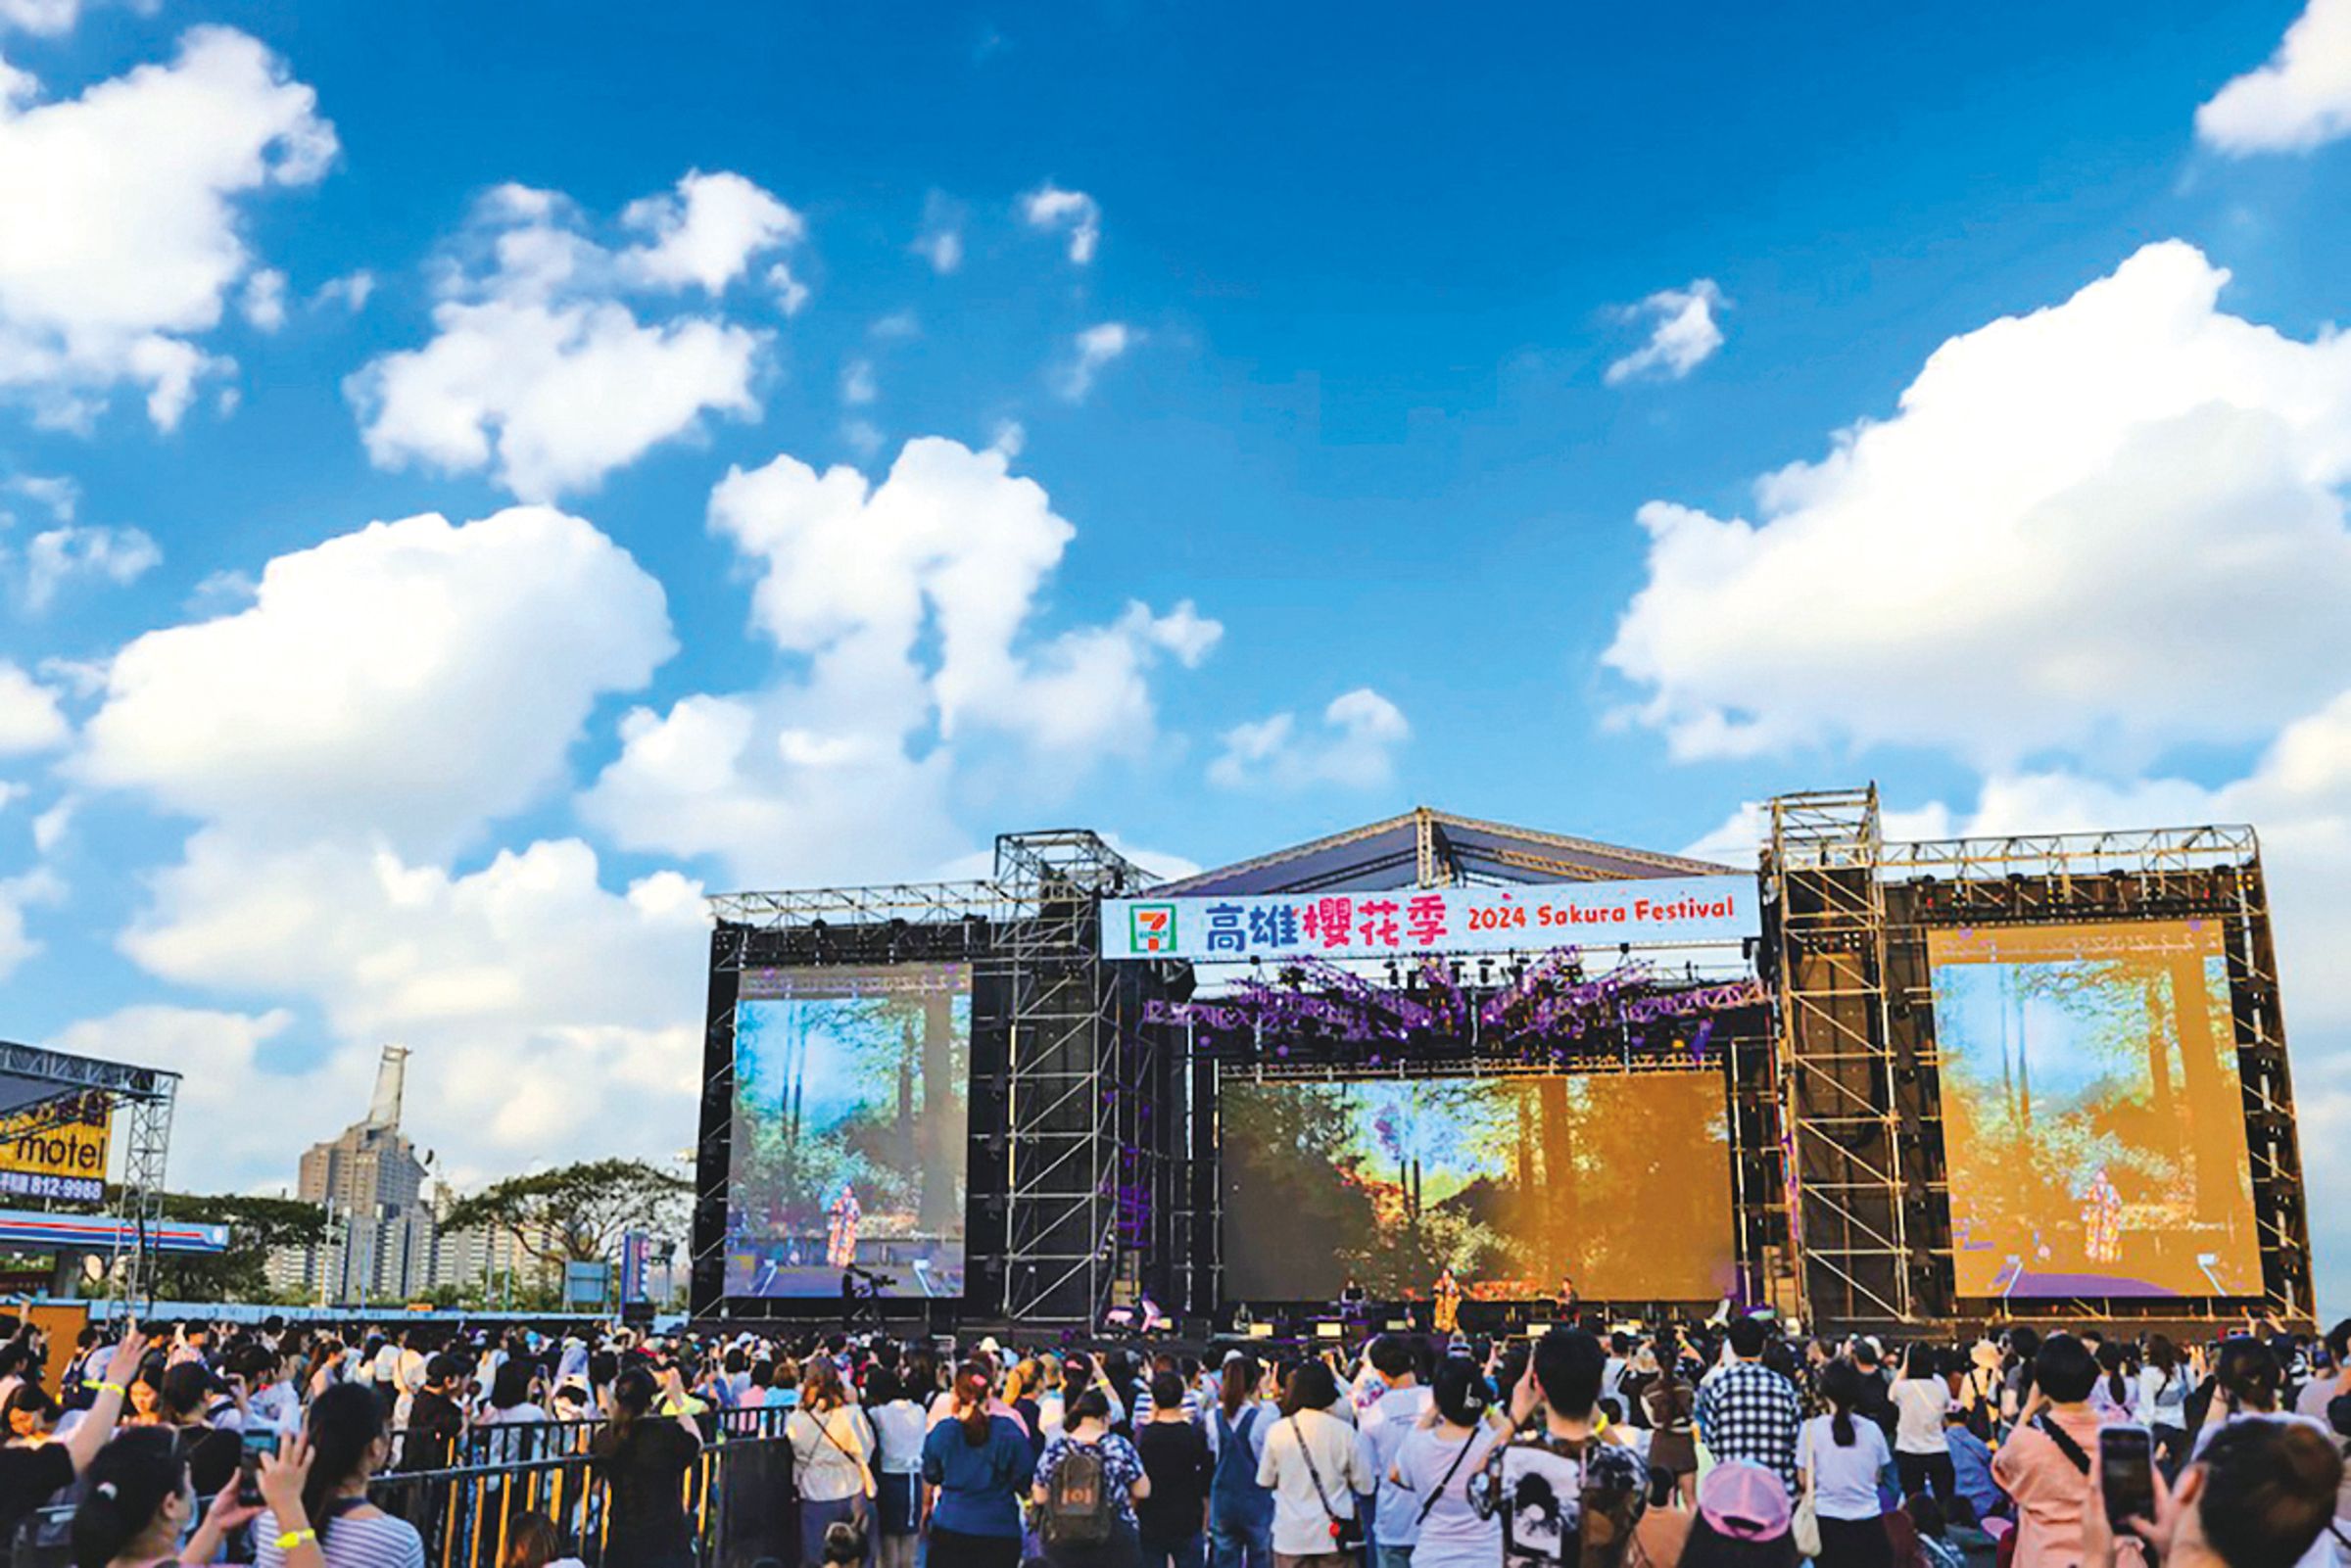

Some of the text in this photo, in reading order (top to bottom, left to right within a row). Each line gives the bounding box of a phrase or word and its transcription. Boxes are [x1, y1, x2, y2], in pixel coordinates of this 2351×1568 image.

[1206, 895, 1447, 952] 高雄櫻花季
[1468, 896, 1734, 930] 2024 Sakura Festival
[18, 1133, 105, 1170] motel
